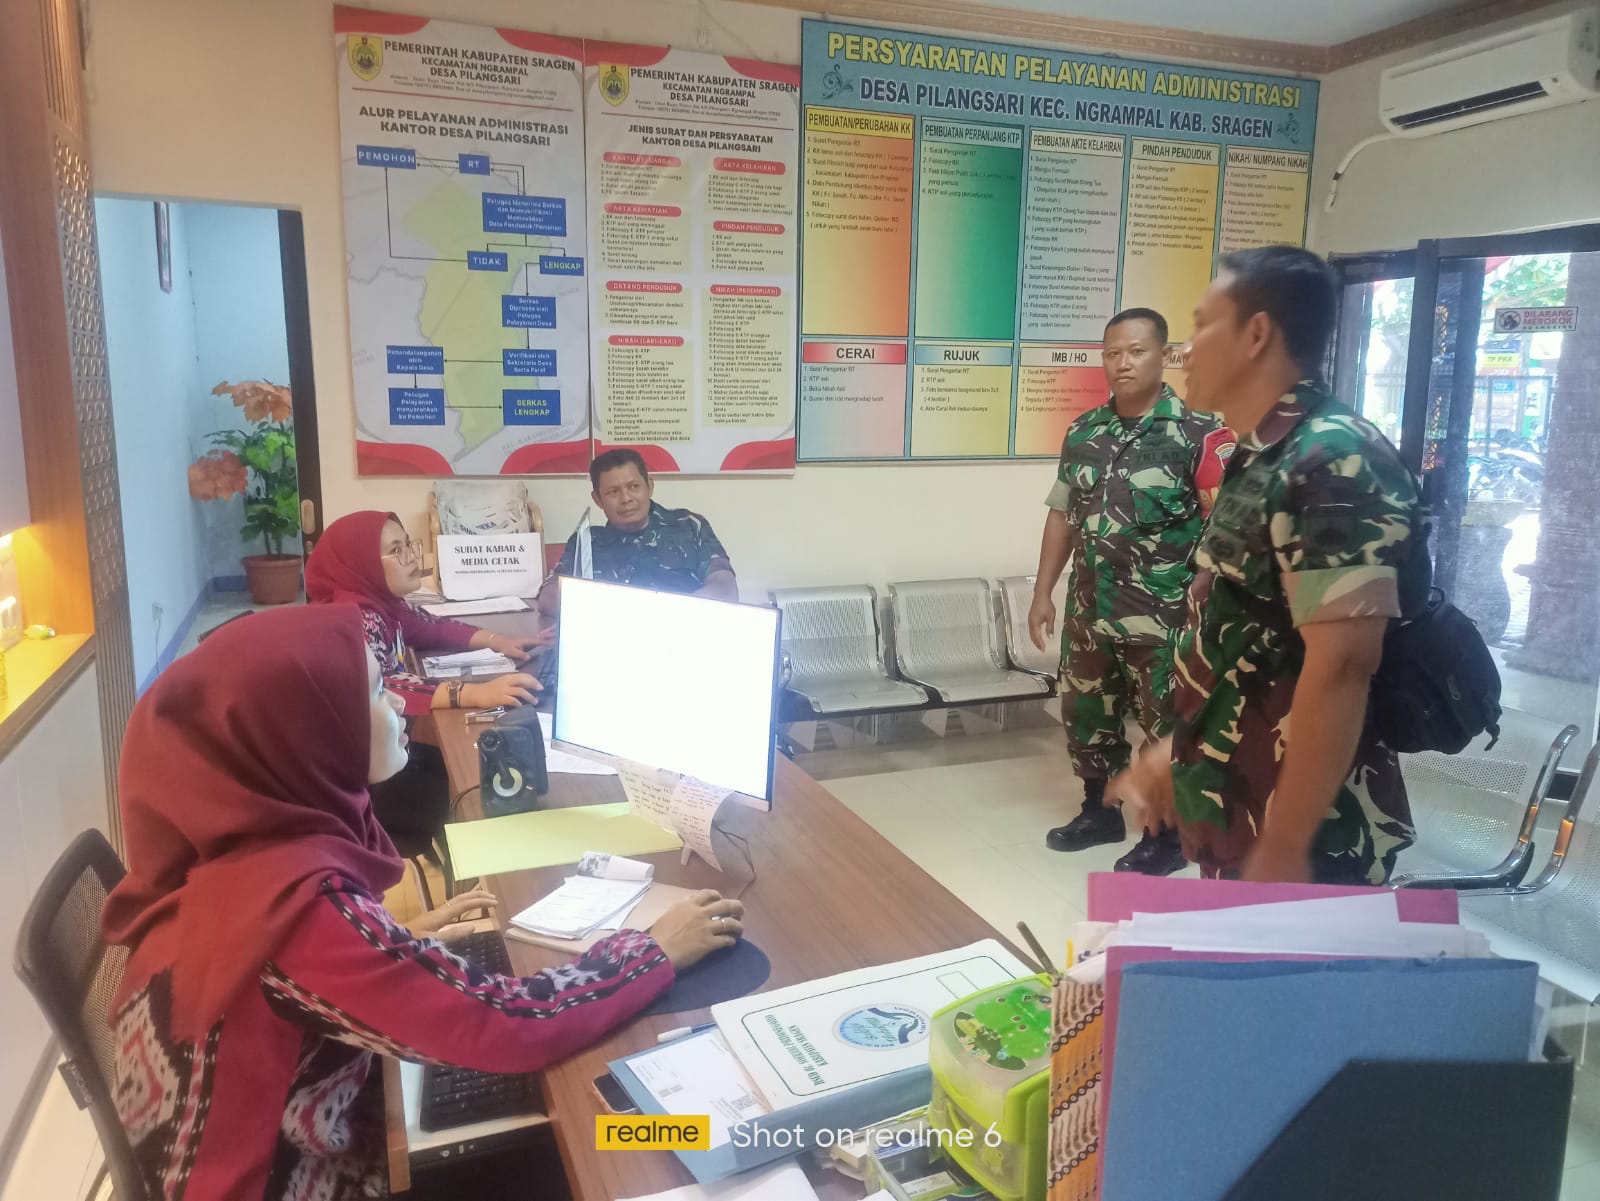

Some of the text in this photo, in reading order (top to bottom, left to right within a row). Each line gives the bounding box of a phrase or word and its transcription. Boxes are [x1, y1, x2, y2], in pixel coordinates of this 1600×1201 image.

[385, 41, 575, 71] PEMERINTAH KABUPATEN SRAGEN
[422, 57, 528, 76] KECAMATAN NGRAMPAL
[828, 32, 1300, 109] PERSYARATAN PELAYANAN ADMINISTRASI
[430, 67, 521, 85] DESA PILANGSARI
[631, 68, 797, 92] PEMERINTAH KABUPATEN SRAGEN
[663, 84, 756, 98] KECAMATAN NGRAMPAL
[670, 92, 749, 107] DESA PILANGSARI
[860, 77, 1273, 139] DESA PILANGSARI KEC. NGRAMPAL KAB. SRAGEN
[360, 107, 568, 135] ALUR PELAYANAN ADMINISTRASI
[809, 114, 910, 134] PEMBUATAN/PERUBAHAN KK
[381, 122, 550, 145] KANTOR DESA PILANGSARI
[629, 125, 773, 143] JENIS SURAT DAN PERSYARATAN
[926, 125, 1019, 143] PEMBUATAN PERPANJANG KTP
[642, 136, 761, 153] KANTOR DESA PILANGSARI
[1034, 135, 1121, 152] PEMBUATAN AKTE KELAHIRAN
[359, 152, 414, 163] PEMOHON
[1143, 145, 1211, 160] PINDAH PENDUDUK
[468, 160, 479, 168] RT
[1253, 155, 1285, 166] NUMPANG
[1288, 158, 1307, 168] NIKAH
[545, 262, 581, 270] LENGKAP
[837, 348, 874, 358] CERAI
[944, 350, 980, 360] RUJUK
[1052, 352, 1067, 362] IMB
[1075, 353, 1087, 362] HO
